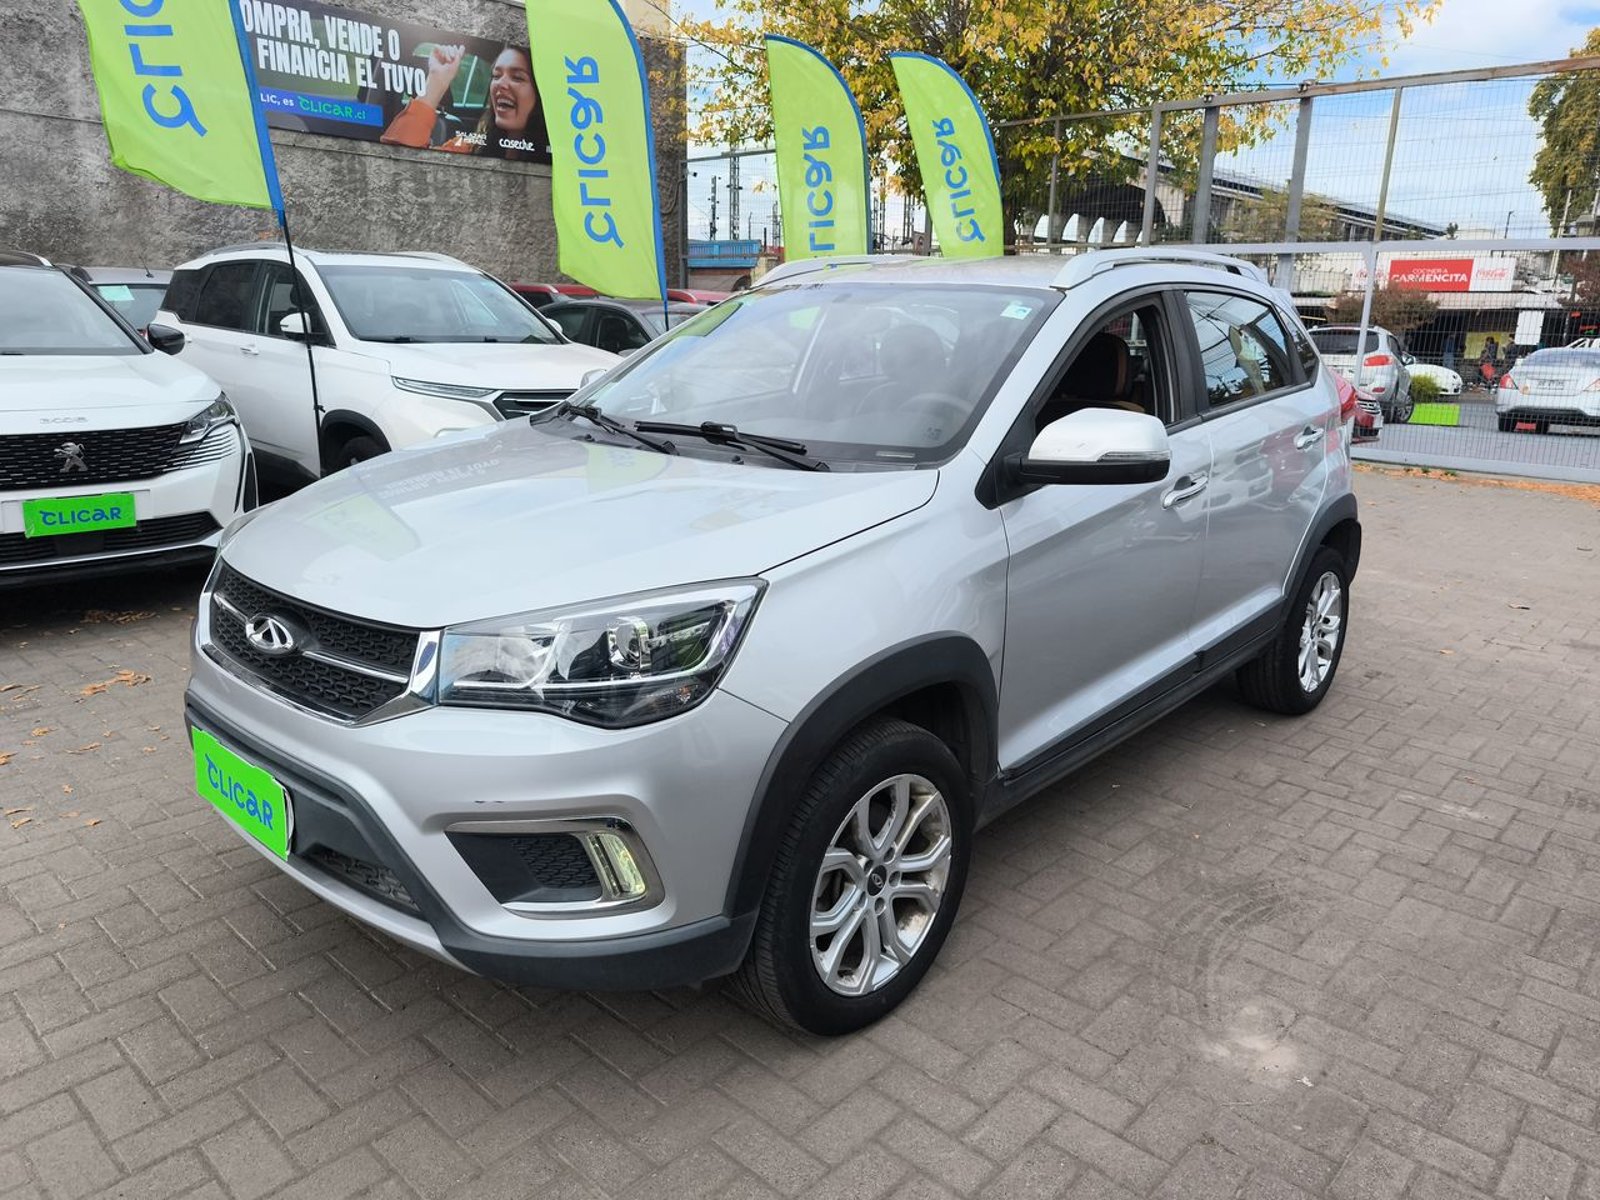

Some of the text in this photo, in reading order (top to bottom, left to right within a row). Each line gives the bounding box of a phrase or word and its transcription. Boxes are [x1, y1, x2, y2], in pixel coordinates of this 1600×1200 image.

[239, 0, 401, 61] OMPRA, VENDE O
[256, 38, 427, 97] FINANCIA EL TUYO
[260, 93, 281, 106] LIC,
[283, 98, 294, 107] es
[802, 126, 835, 252] LICaR
[1391, 273, 1468, 282] CARMENCITA
